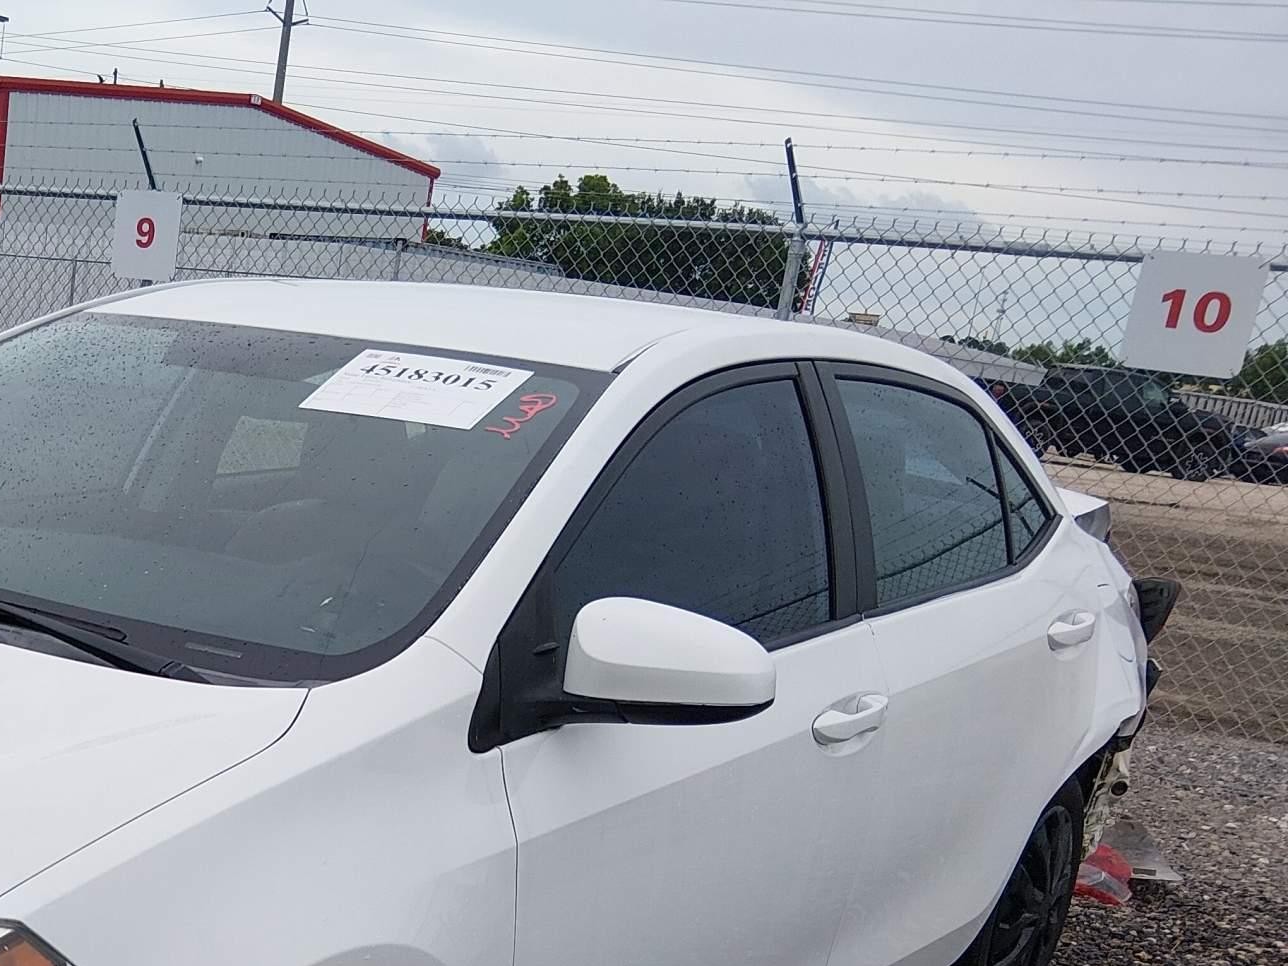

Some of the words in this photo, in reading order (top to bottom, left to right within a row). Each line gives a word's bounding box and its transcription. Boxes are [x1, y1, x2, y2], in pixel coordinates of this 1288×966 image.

[135, 217, 156, 249] 9
[1161, 288, 1233, 334] 10
[360, 363, 497, 391] 45183015
